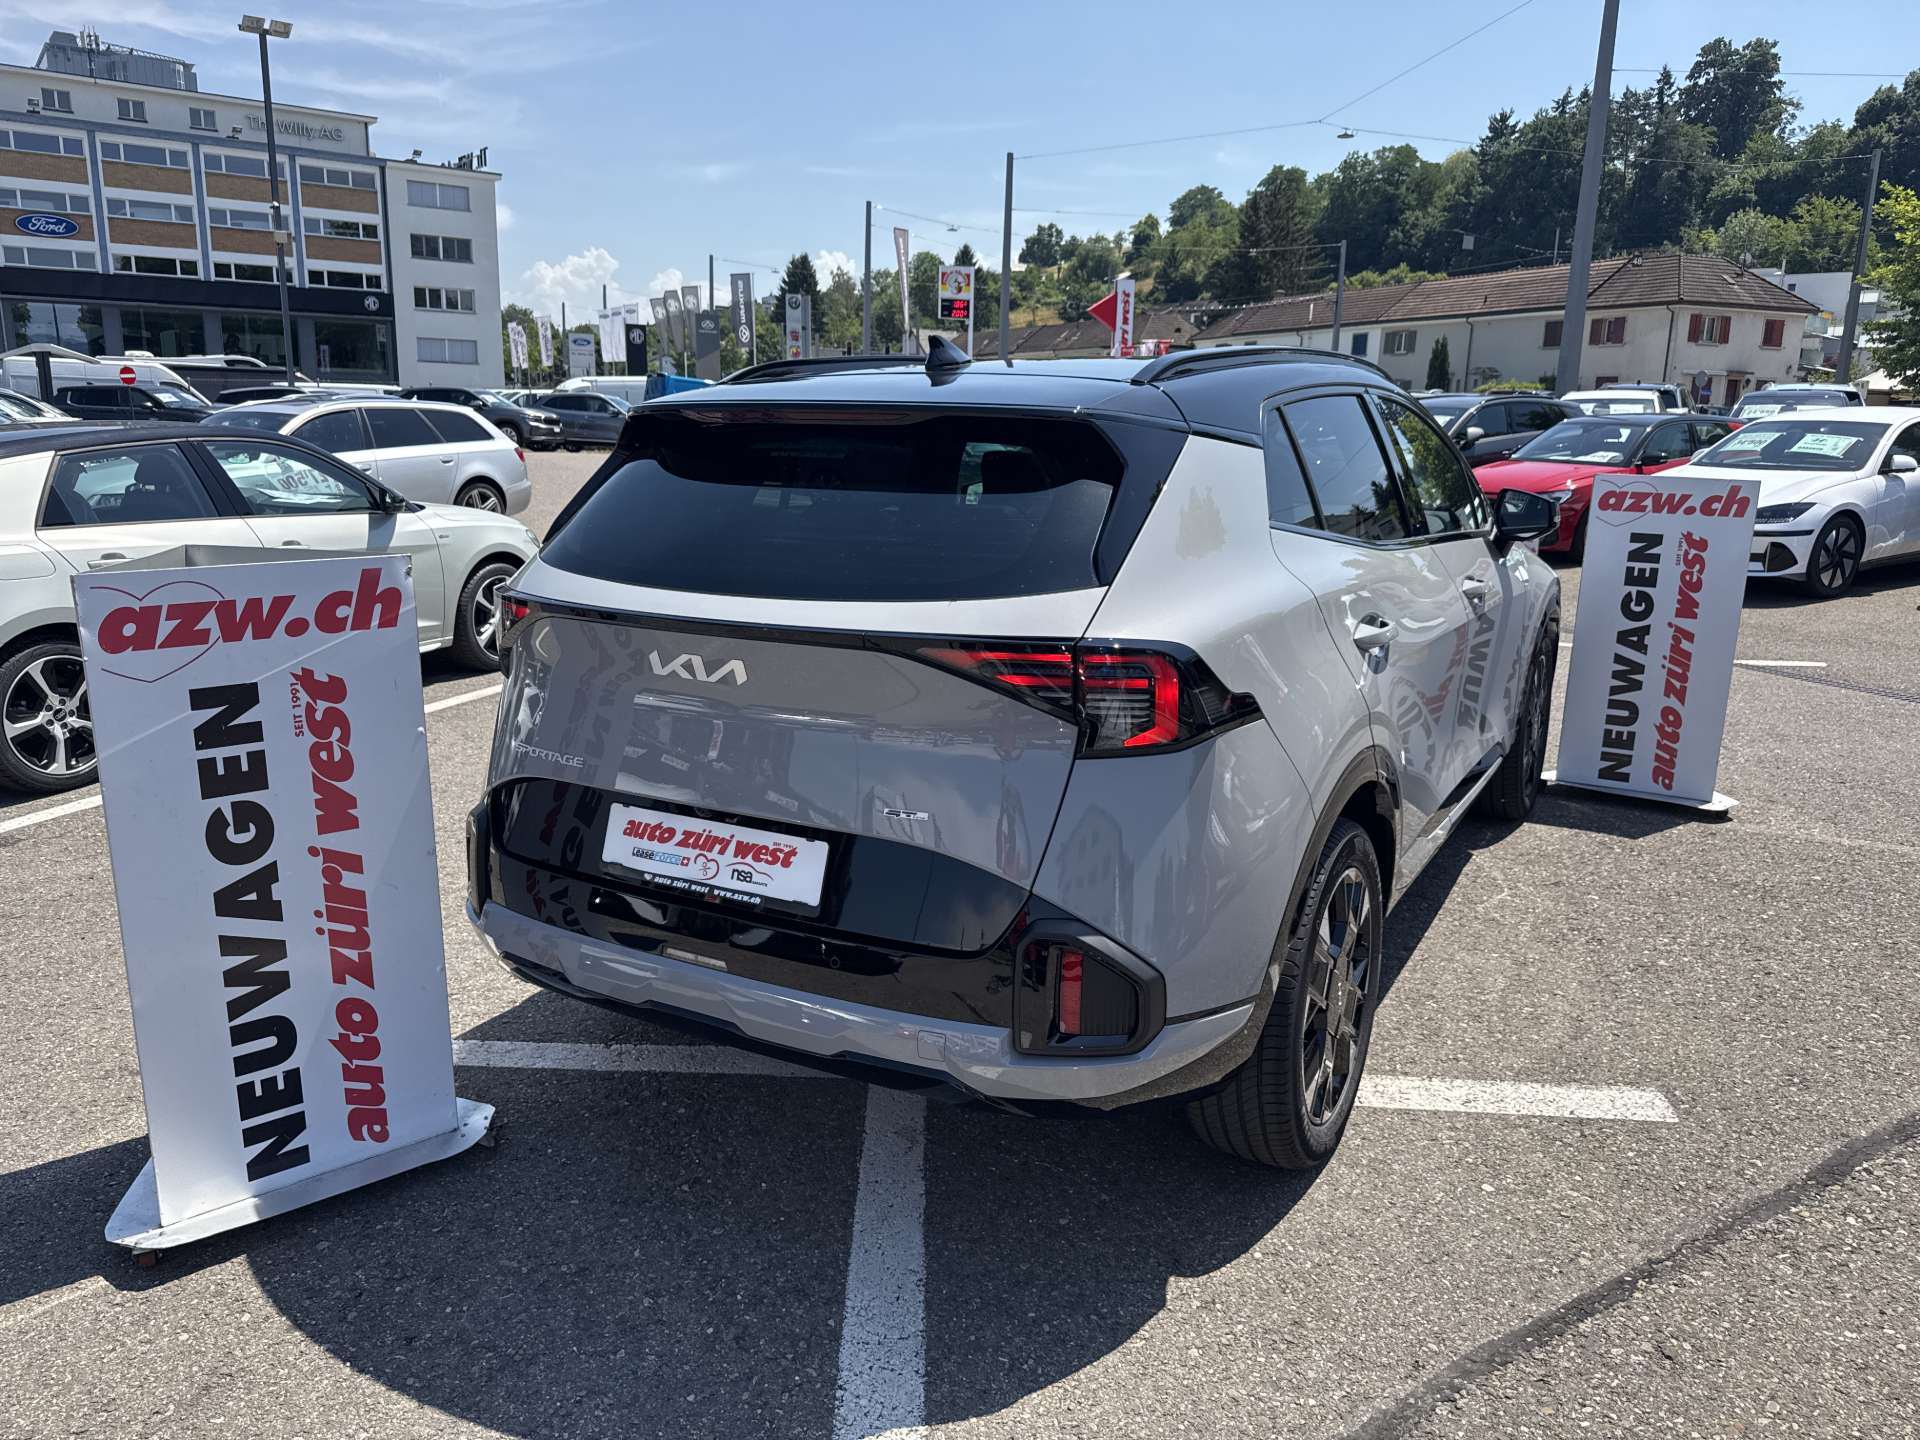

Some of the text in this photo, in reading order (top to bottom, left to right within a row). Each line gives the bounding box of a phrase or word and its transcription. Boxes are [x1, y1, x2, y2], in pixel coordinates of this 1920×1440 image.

[277, 119, 313, 140] Willy
[320, 125, 344, 142] AG
[28, 215, 67, 233] Ford
[364, 295, 380, 312] MG
[1122, 289, 1130, 326] west
[629, 327, 645, 345] MG
[1597, 485, 1750, 518] azw.ch
[97, 567, 403, 655] azw.ch
[649, 650, 748, 686] KIA
[1597, 532, 1665, 783] NEUWAGEN
[1652, 530, 1708, 791] auto züri west
[289, 681, 305, 738] SEIT 1991
[513, 741, 585, 768] SPORTAGE
[622, 819, 798, 868] auto züri west
[654, 876, 761, 904] auto züri west www.azw.ch
[731, 868, 753, 883] nsa
[290, 667, 390, 1143] auto züri west
[188, 681, 311, 1184] NEUWAGEN
